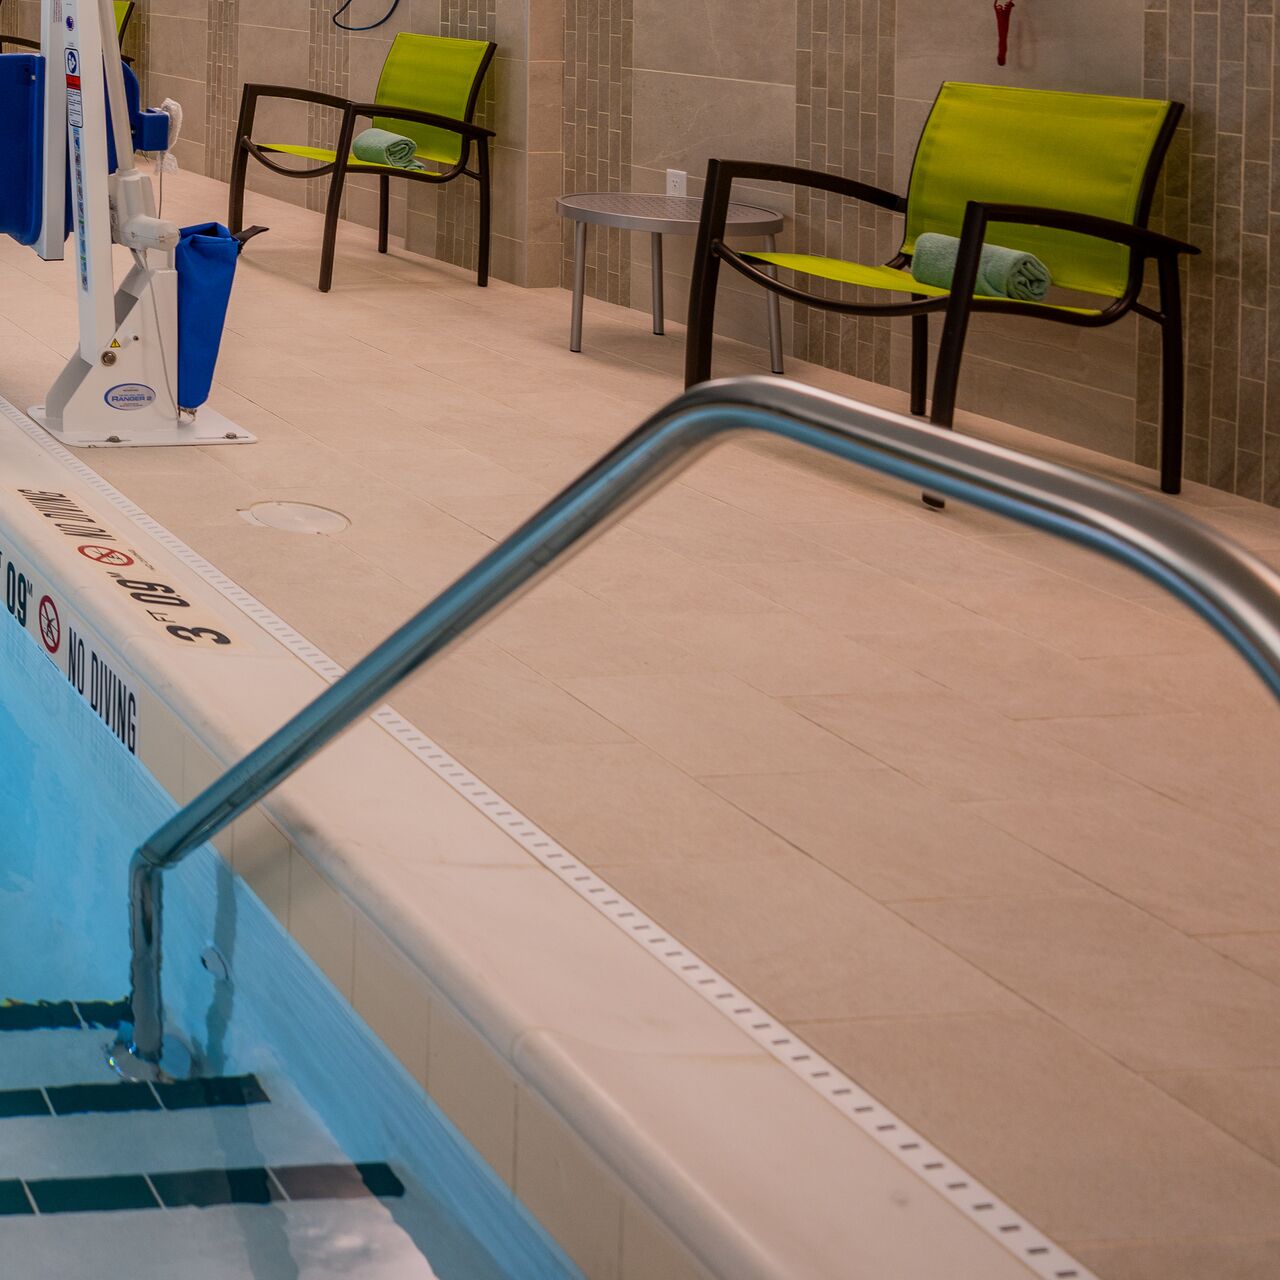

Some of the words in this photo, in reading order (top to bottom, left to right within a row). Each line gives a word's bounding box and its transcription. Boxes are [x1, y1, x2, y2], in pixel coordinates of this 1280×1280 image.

[17, 489, 97, 523] DIVING
[54, 523, 117, 541] NO
[146, 609, 176, 623] FT
[165, 625, 231, 645] 3
[67, 626, 85, 696] NO
[89, 650, 137, 756] DIVING
